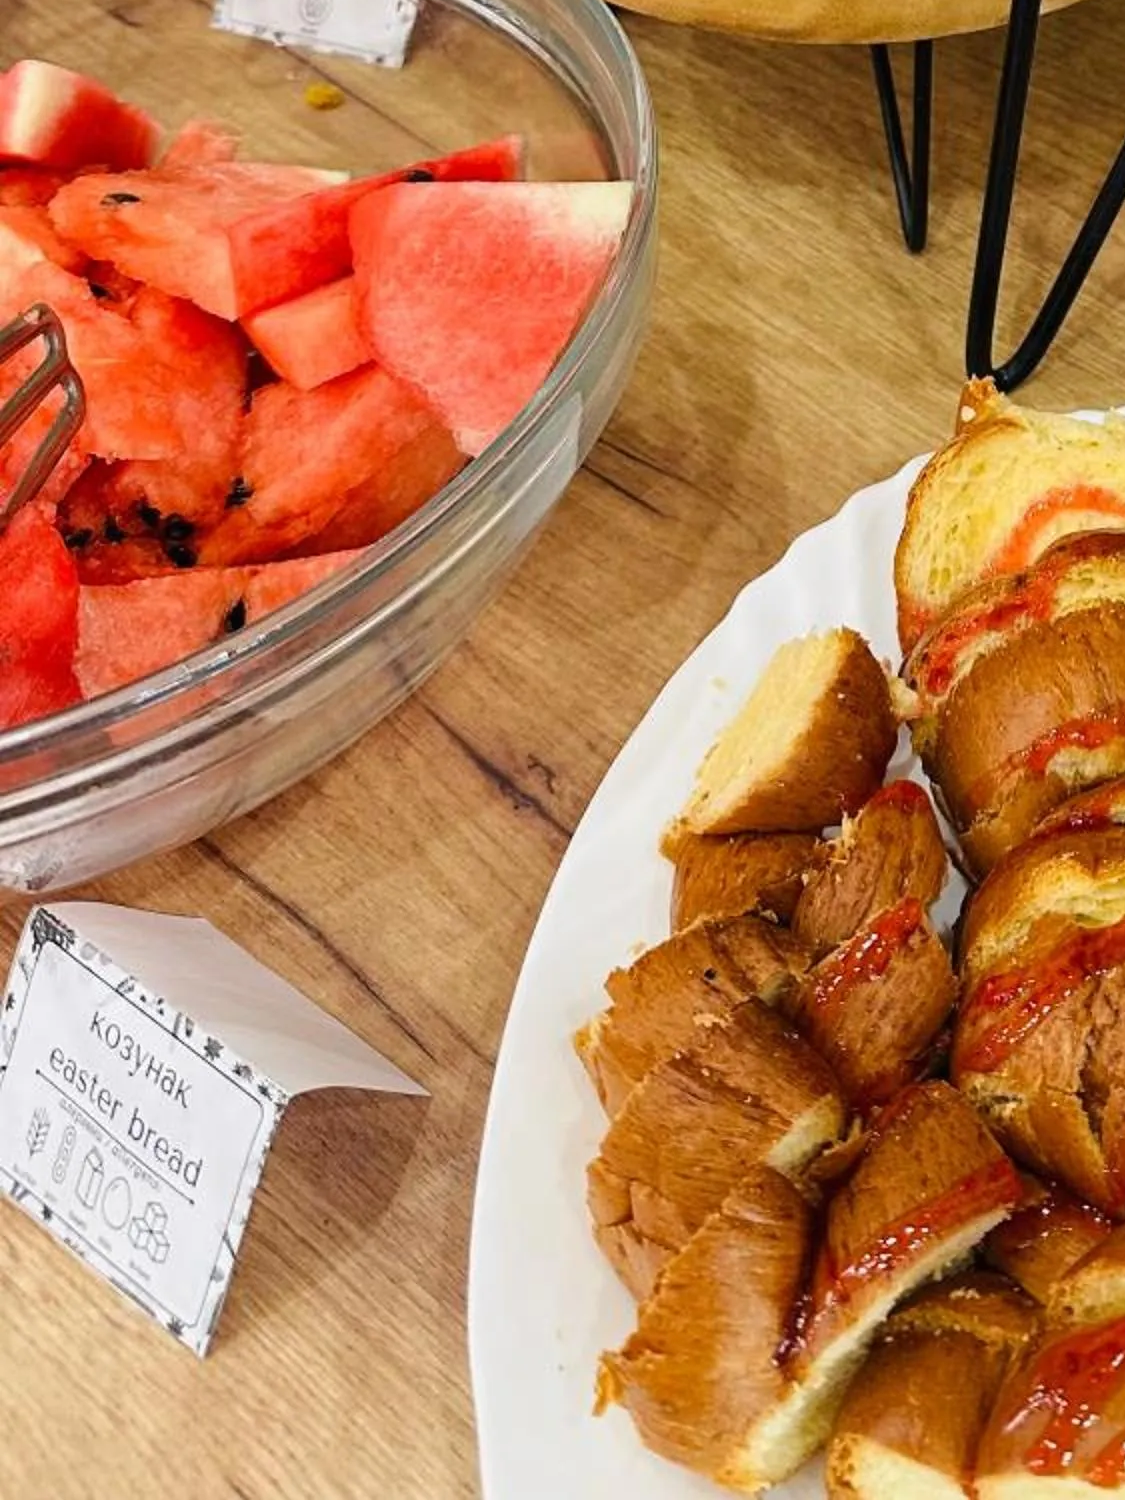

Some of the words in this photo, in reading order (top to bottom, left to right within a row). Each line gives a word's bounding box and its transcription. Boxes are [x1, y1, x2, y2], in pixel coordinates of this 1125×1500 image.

[49, 1044, 124, 1120] easter
[127, 1107, 204, 1188] bread
[89, 1011, 193, 1109] козунак
